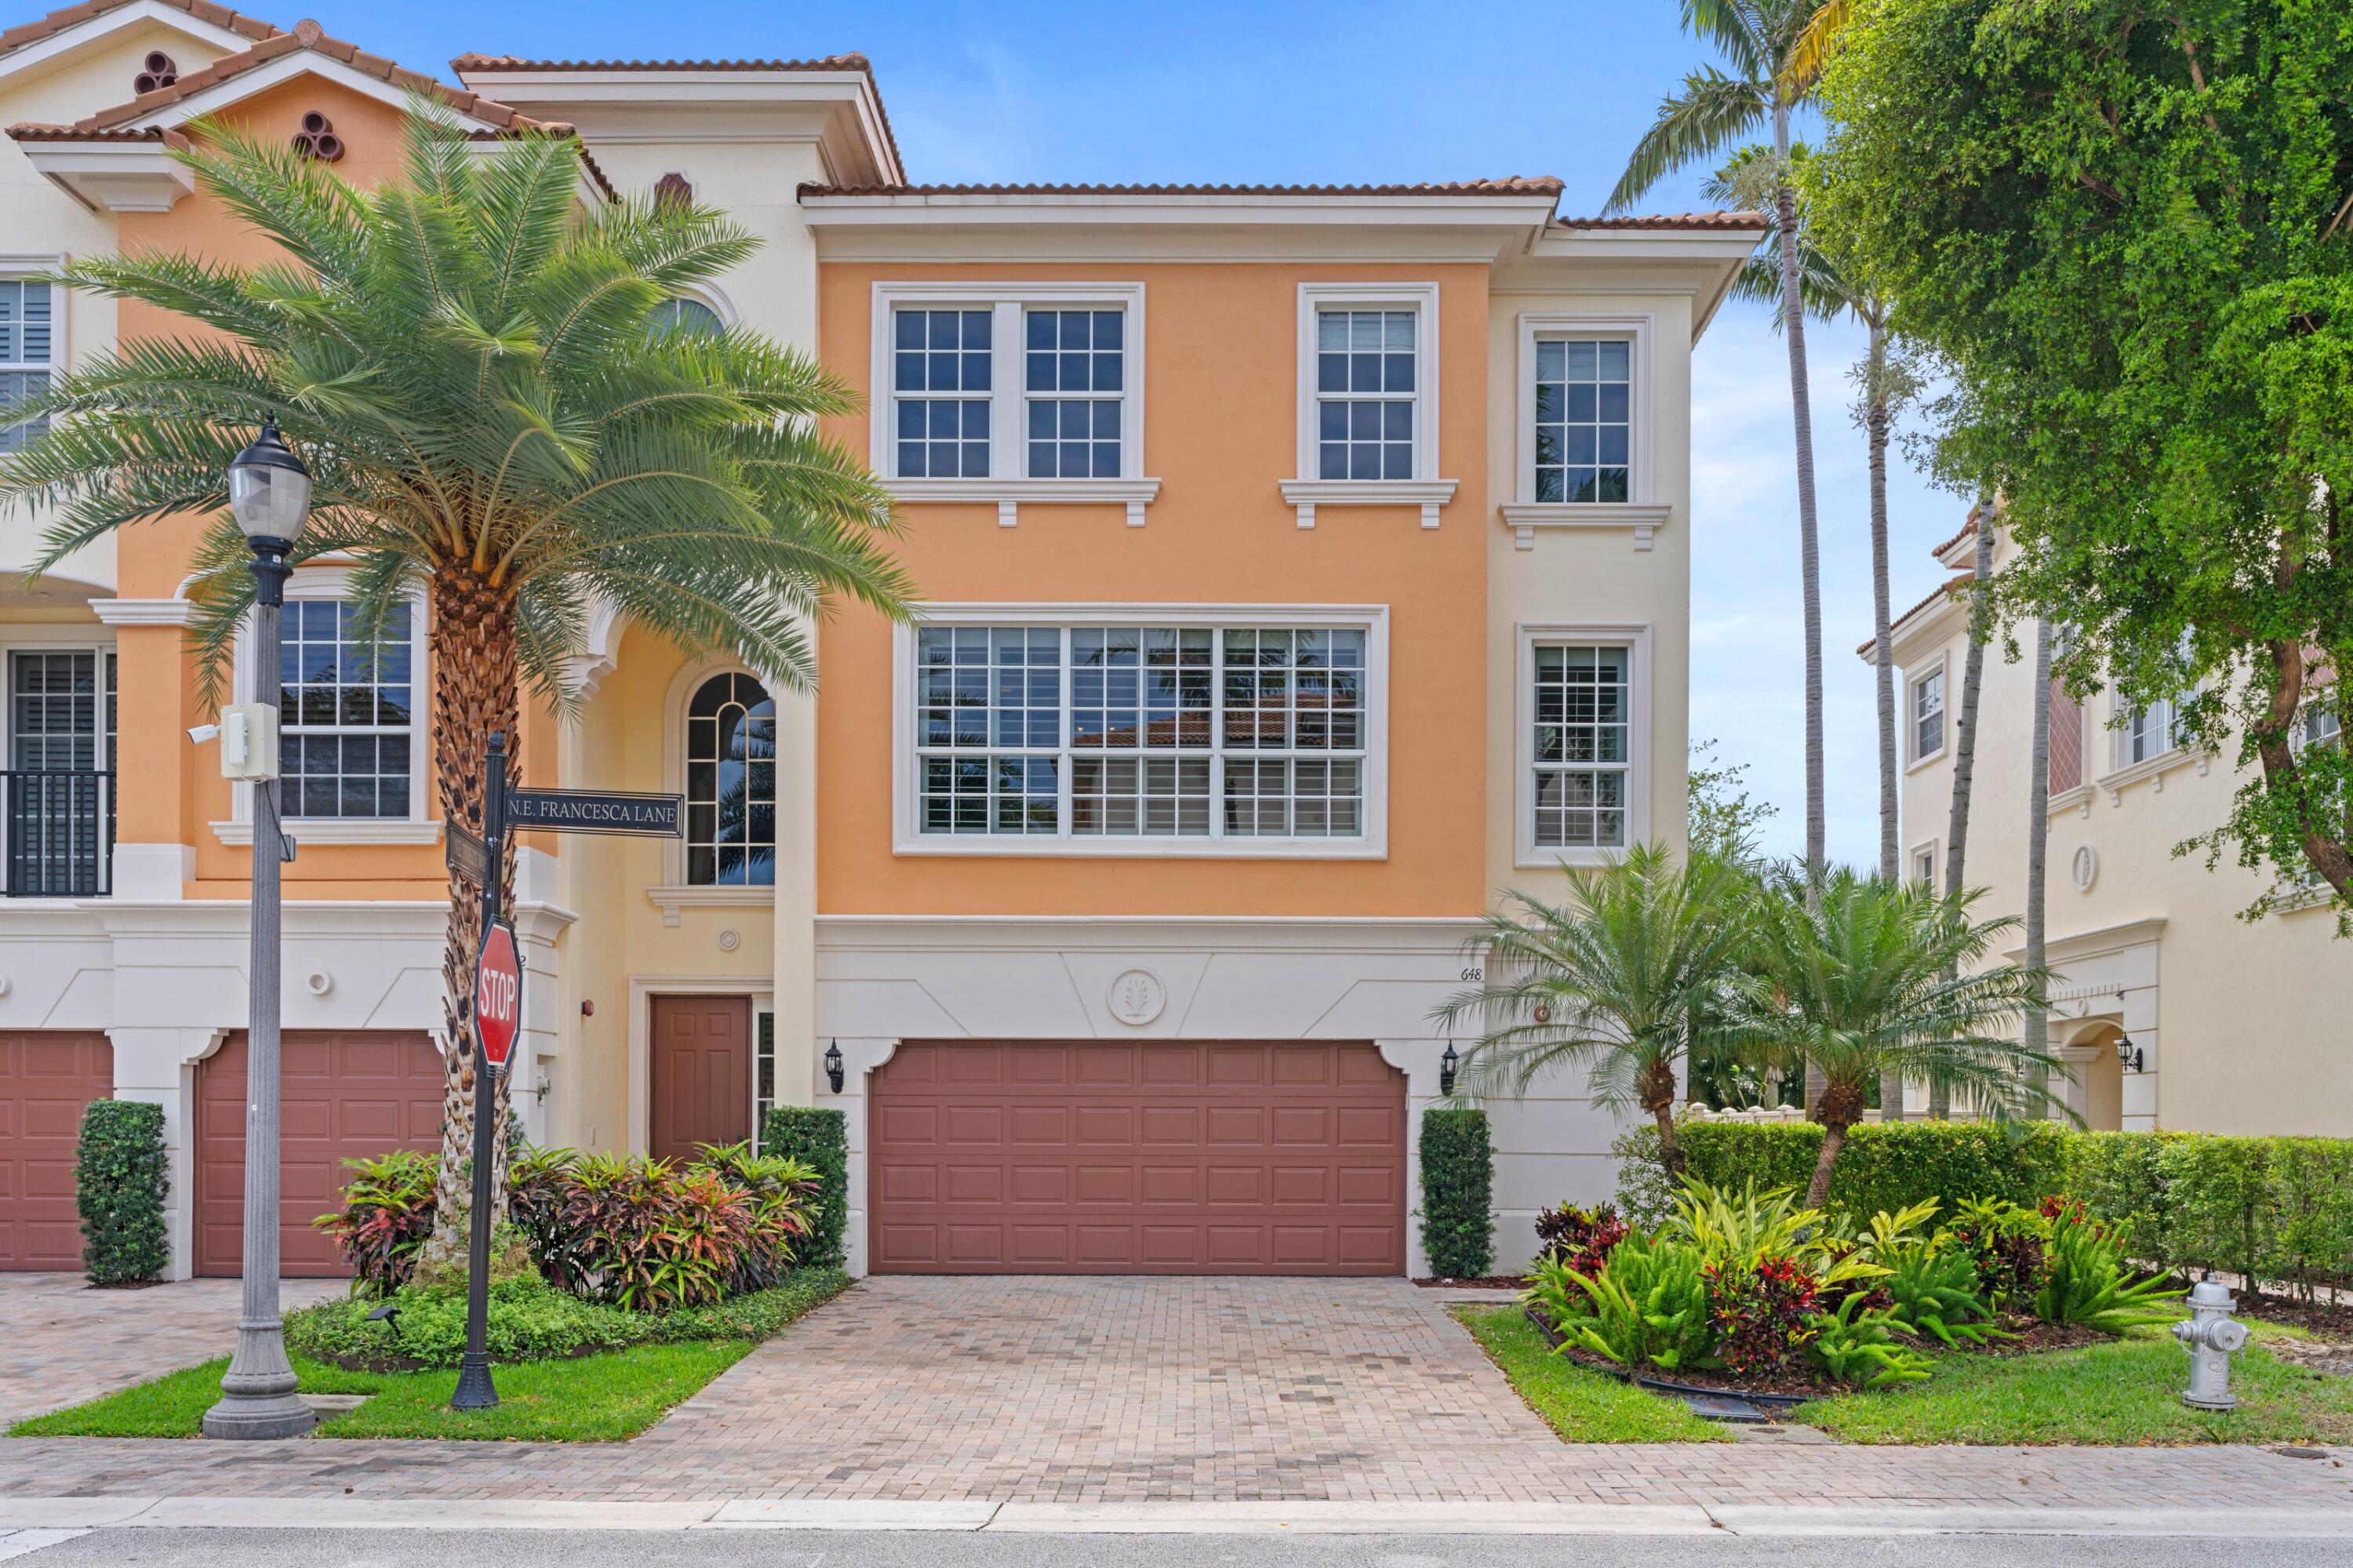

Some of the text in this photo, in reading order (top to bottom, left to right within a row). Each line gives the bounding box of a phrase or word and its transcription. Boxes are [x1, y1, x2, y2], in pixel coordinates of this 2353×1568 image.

[509, 800, 676, 823] N.E. FRANCESCA LANE
[1461, 968, 1482, 980] 648
[481, 967, 515, 1020] STOP
